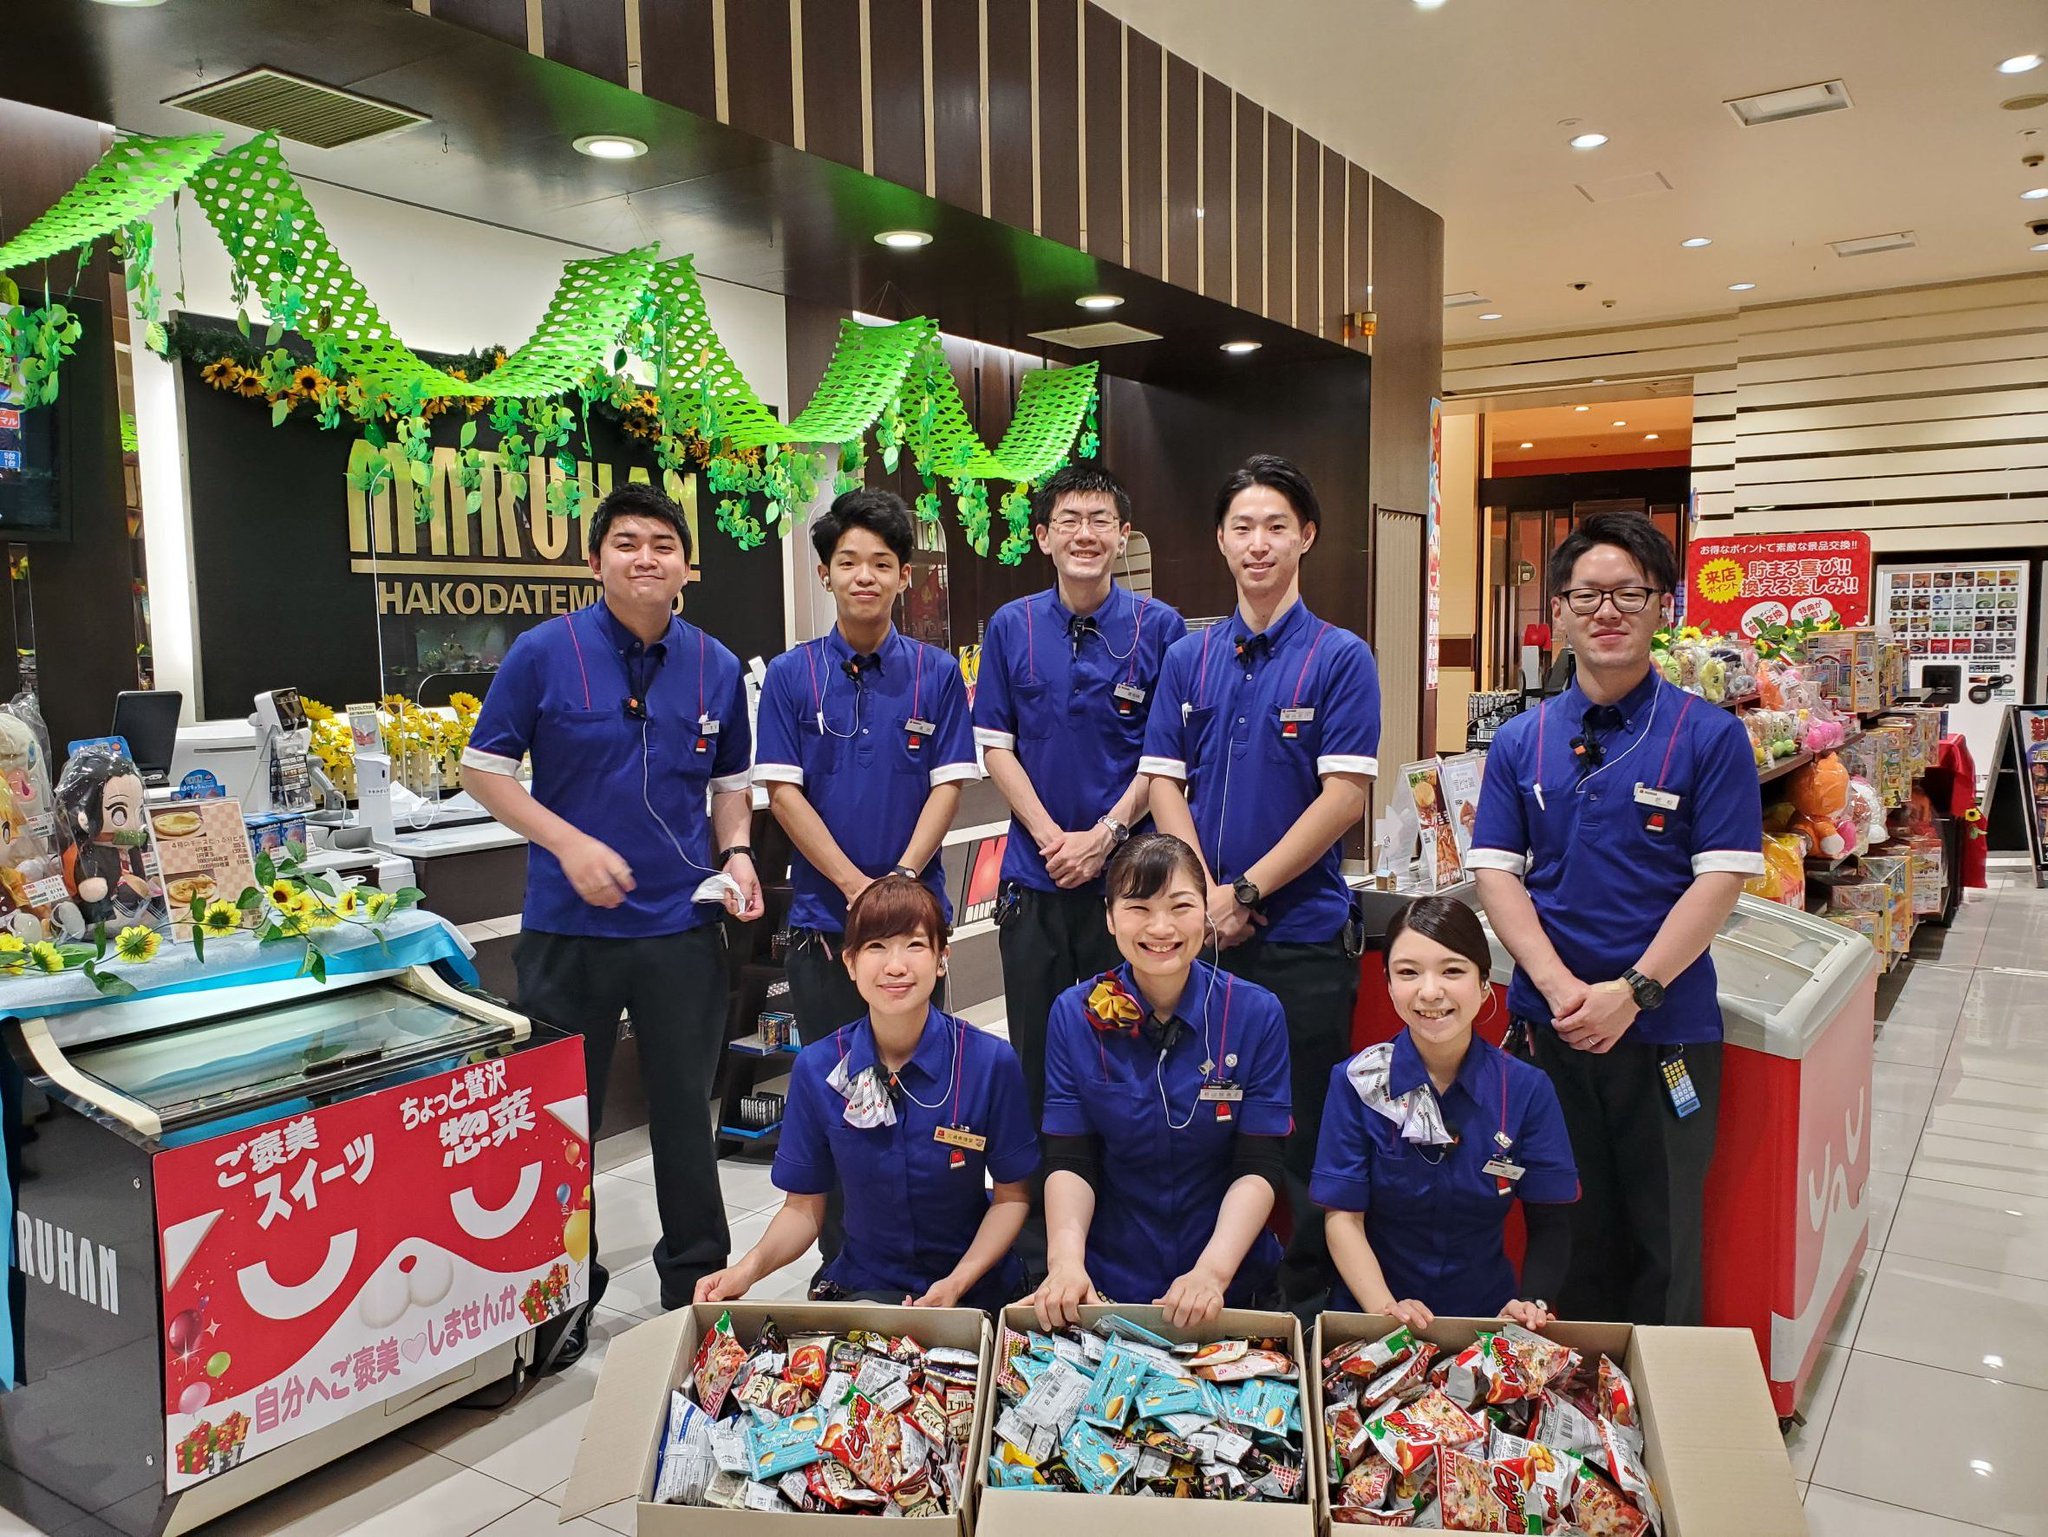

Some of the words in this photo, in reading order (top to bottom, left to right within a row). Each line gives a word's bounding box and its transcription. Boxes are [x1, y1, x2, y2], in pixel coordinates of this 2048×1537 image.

[348, 439, 700, 565] MARUHN
[1705, 567, 1737, 585] 来店
[1708, 582, 1738, 594] ポイント
[400, 1059, 507, 1131] ちょっと贅沢
[439, 1087, 536, 1168] 惣菜
[215, 1115, 320, 1188] ご褒美
[254, 1133, 375, 1231] スイーツ
[17, 1210, 119, 1315] RUHAN
[256, 1336, 401, 1434] 自分へご褒美
[427, 1284, 517, 1357] しませんか
[1445, 1450, 1457, 1485] PIZZA
